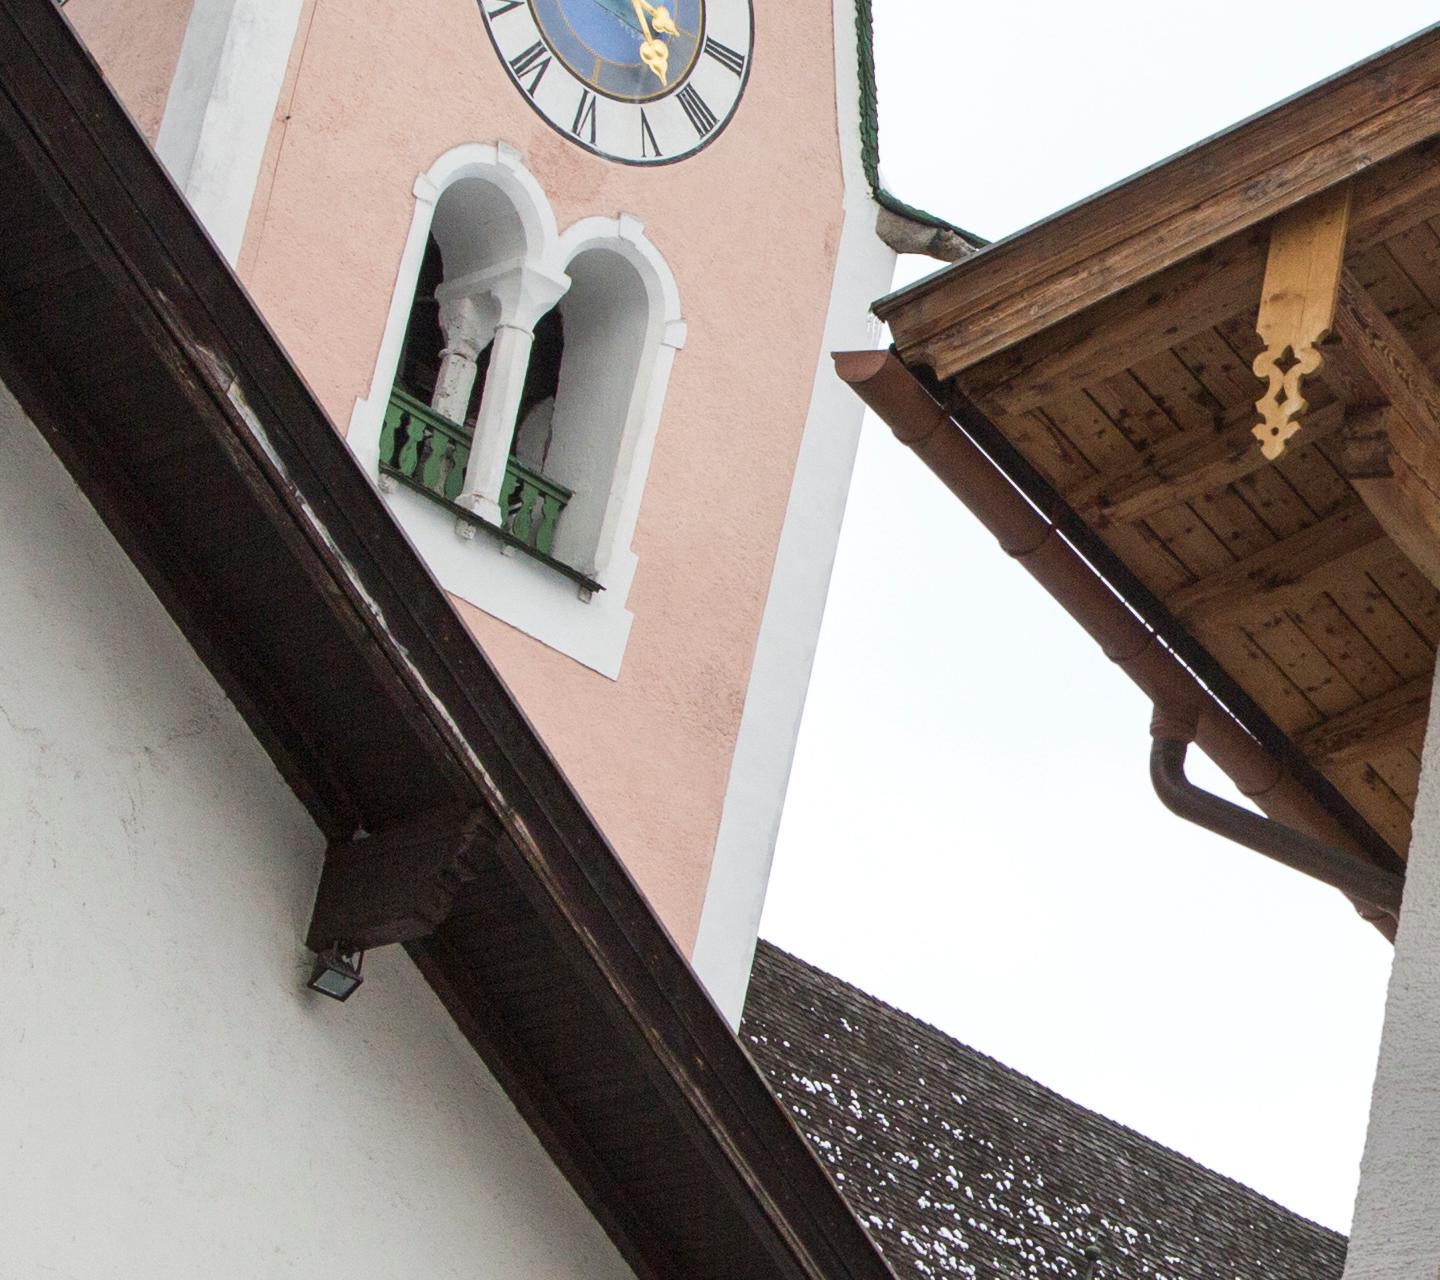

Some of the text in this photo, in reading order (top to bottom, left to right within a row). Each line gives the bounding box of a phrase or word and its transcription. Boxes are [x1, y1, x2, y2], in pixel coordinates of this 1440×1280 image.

[510, 40, 552, 97] VII
[705, 37, 745, 77] III
[572, 89, 596, 145] VI
[640, 108, 662, 157] V
[677, 83, 719, 139] IIII
